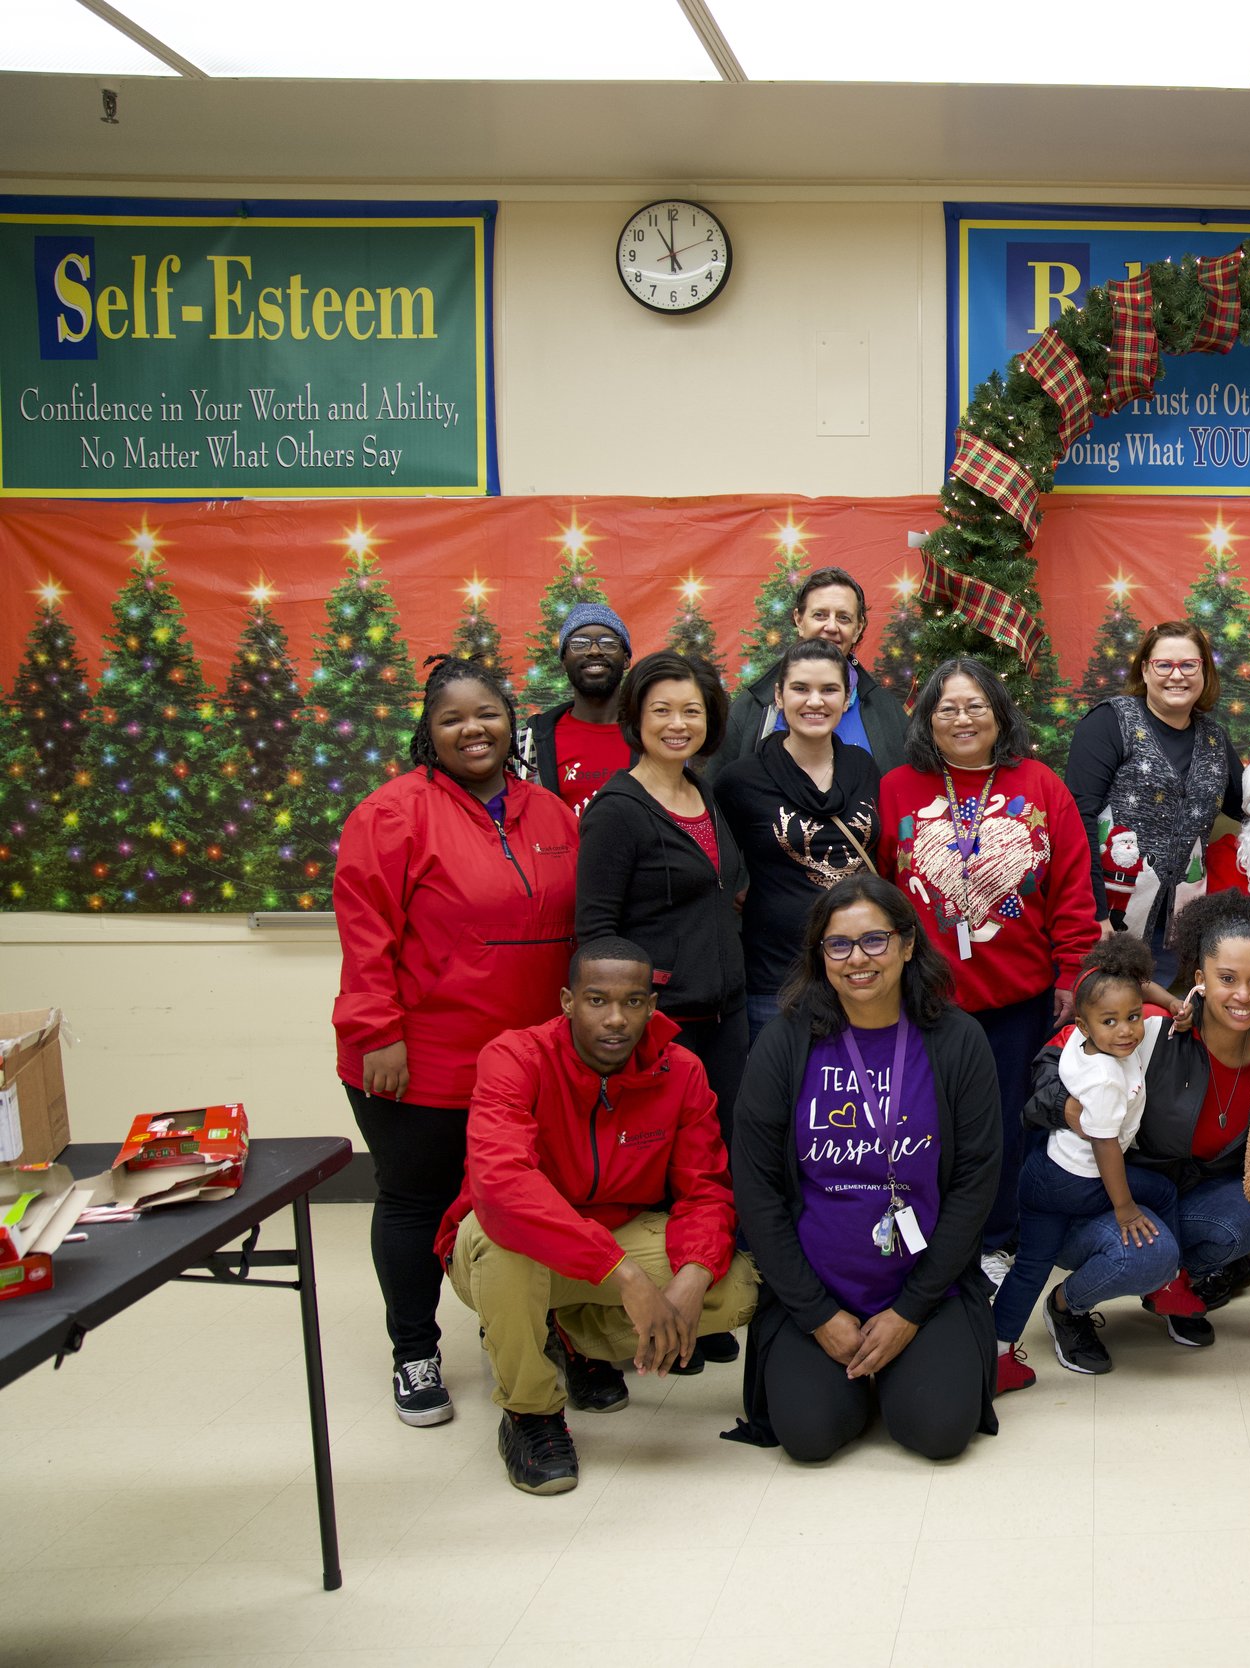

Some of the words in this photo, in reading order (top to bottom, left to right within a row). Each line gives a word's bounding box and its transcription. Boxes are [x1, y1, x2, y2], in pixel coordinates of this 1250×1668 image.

[648, 214, 657, 227] 11
[633, 229, 645, 242] 10
[706, 230, 713, 241] 2
[628, 250, 636, 262] 9
[711, 250, 718, 261] 3
[634, 271, 642, 283] 8
[705, 271, 713, 282] 4
[649, 285, 657, 297] 7
[670, 291, 677, 303] 6
[691, 285, 698, 297] 5
[54, 252, 438, 343] Self-Esteem
[19, 383, 153, 423] Confidence
[161, 391, 184, 423] in
[190, 389, 243, 423] Your
[248, 384, 319, 422] Worth
[327, 383, 370, 421] and
[375, 382, 459, 428] Ability,
[1196, 383, 1219, 416] of
[80, 435, 115, 470] No
[123, 436, 200, 470] Matter
[206, 430, 269, 470] What
[275, 430, 355, 470] Others
[361, 434, 403, 475] Say
[1125, 433, 1185, 466] What
[835, 1184, 881, 1192] ELEMENTARY
